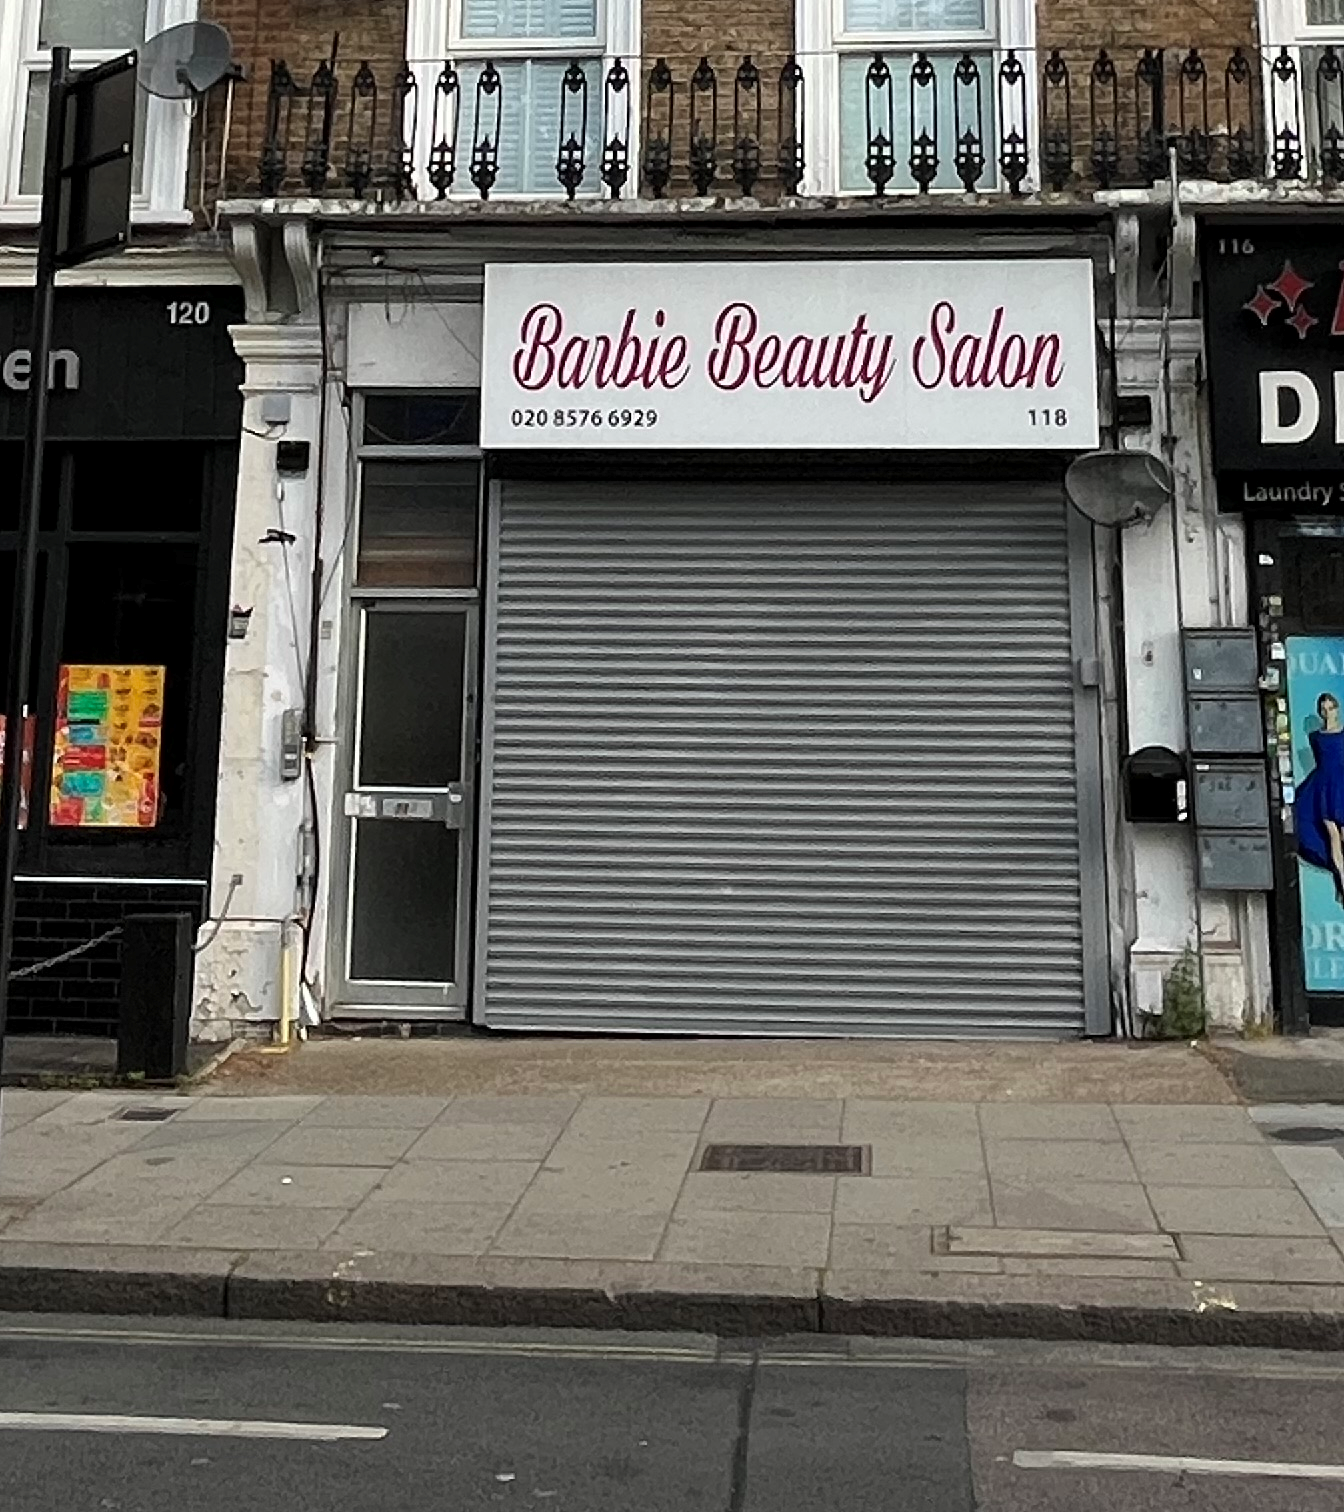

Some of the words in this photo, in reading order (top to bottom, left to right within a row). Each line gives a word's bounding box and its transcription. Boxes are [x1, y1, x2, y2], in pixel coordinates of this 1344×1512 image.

[1218, 238, 1255, 255] 116
[166, 301, 210, 326] 120
[513, 302, 690, 391] Barbie
[707, 302, 897, 404] Beauty
[912, 300, 1065, 390] Salon
[511, 409, 548, 428] 020
[552, 409, 604, 428] 8576
[607, 409, 659, 429] 6929
[1027, 408, 1068, 428] 118
[1243, 481, 1333, 506] Laundry
